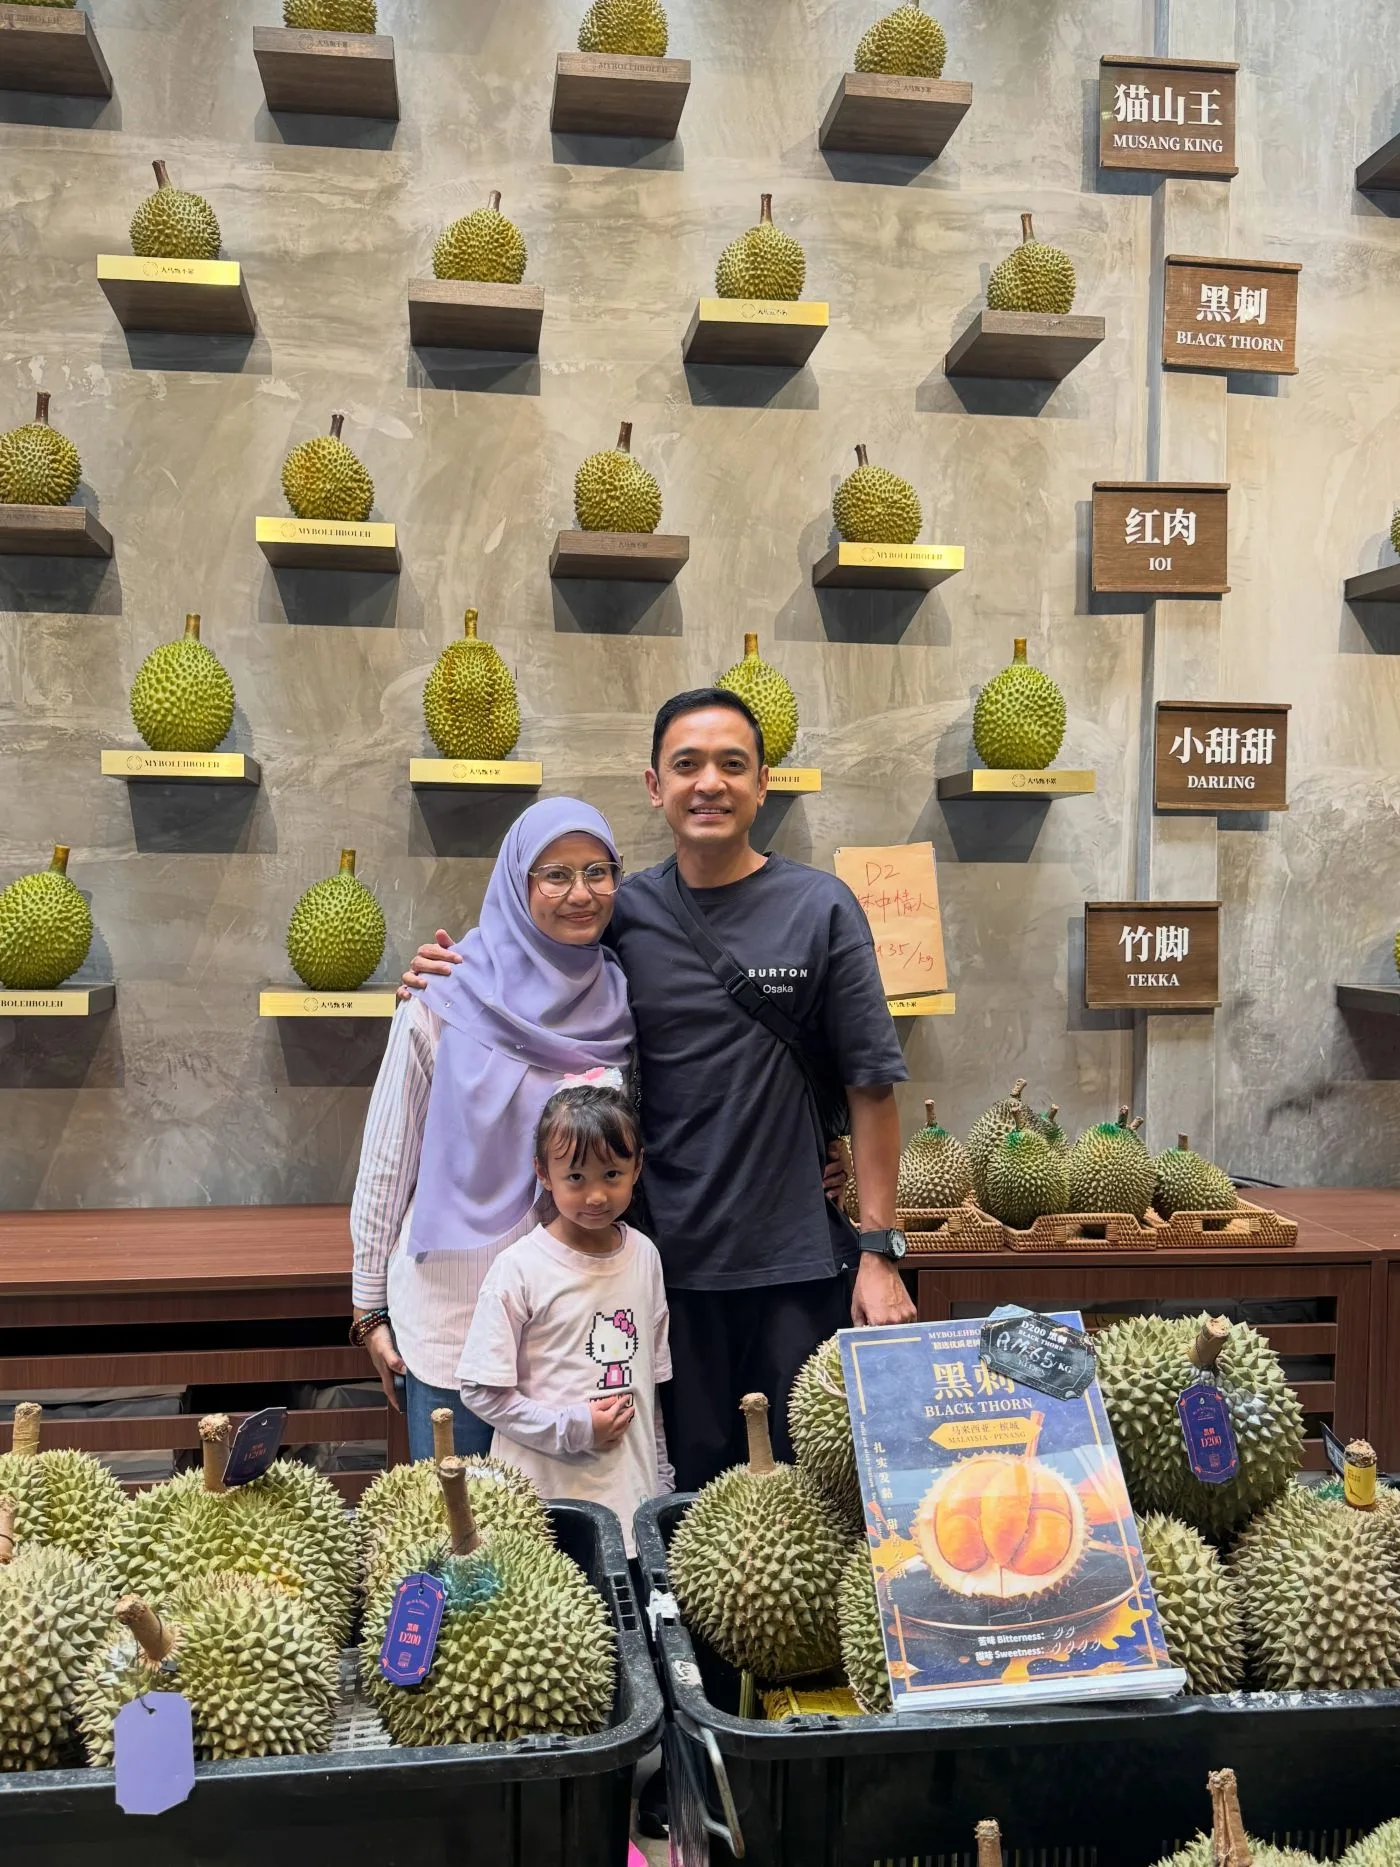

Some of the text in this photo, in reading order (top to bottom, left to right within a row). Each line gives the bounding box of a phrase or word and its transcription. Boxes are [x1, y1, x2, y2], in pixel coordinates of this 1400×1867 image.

[1113, 83, 1223, 126] 猫山王
[1112, 134, 1223, 153] MUSANG KING
[1195, 283, 1269, 326] 黑刺
[1175, 330, 1285, 352] BLACK THORN
[1124, 506, 1197, 546] 红肉
[1168, 726, 1277, 765] 小甜甜
[144, 759, 220, 768] MYBOLEHBOLEH
[1187, 775, 1256, 790] DARLING
[865, 861, 901, 886] D2
[1118, 925, 1190, 962] 竹脚
[748, 967, 808, 978] BURTON
[1126, 972, 1180, 987] TEKKA
[762, 984, 794, 994] Osaka
[1020, 1320, 1047, 1337] D200
[1017, 1328, 1065, 1352] BLACK THORN
[931, 1360, 1016, 1401] 黑刺
[924, 1397, 1034, 1418] BLACK THORN
[947, 1430, 1026, 1444] MALAYSIA PENANG
[1200, 1435, 1222, 1449] D200
[399, 1631, 422, 1647] D200
[996, 1632, 1045, 1644] Bitterness:
[994, 1646, 1045, 1659] Sweetness:
